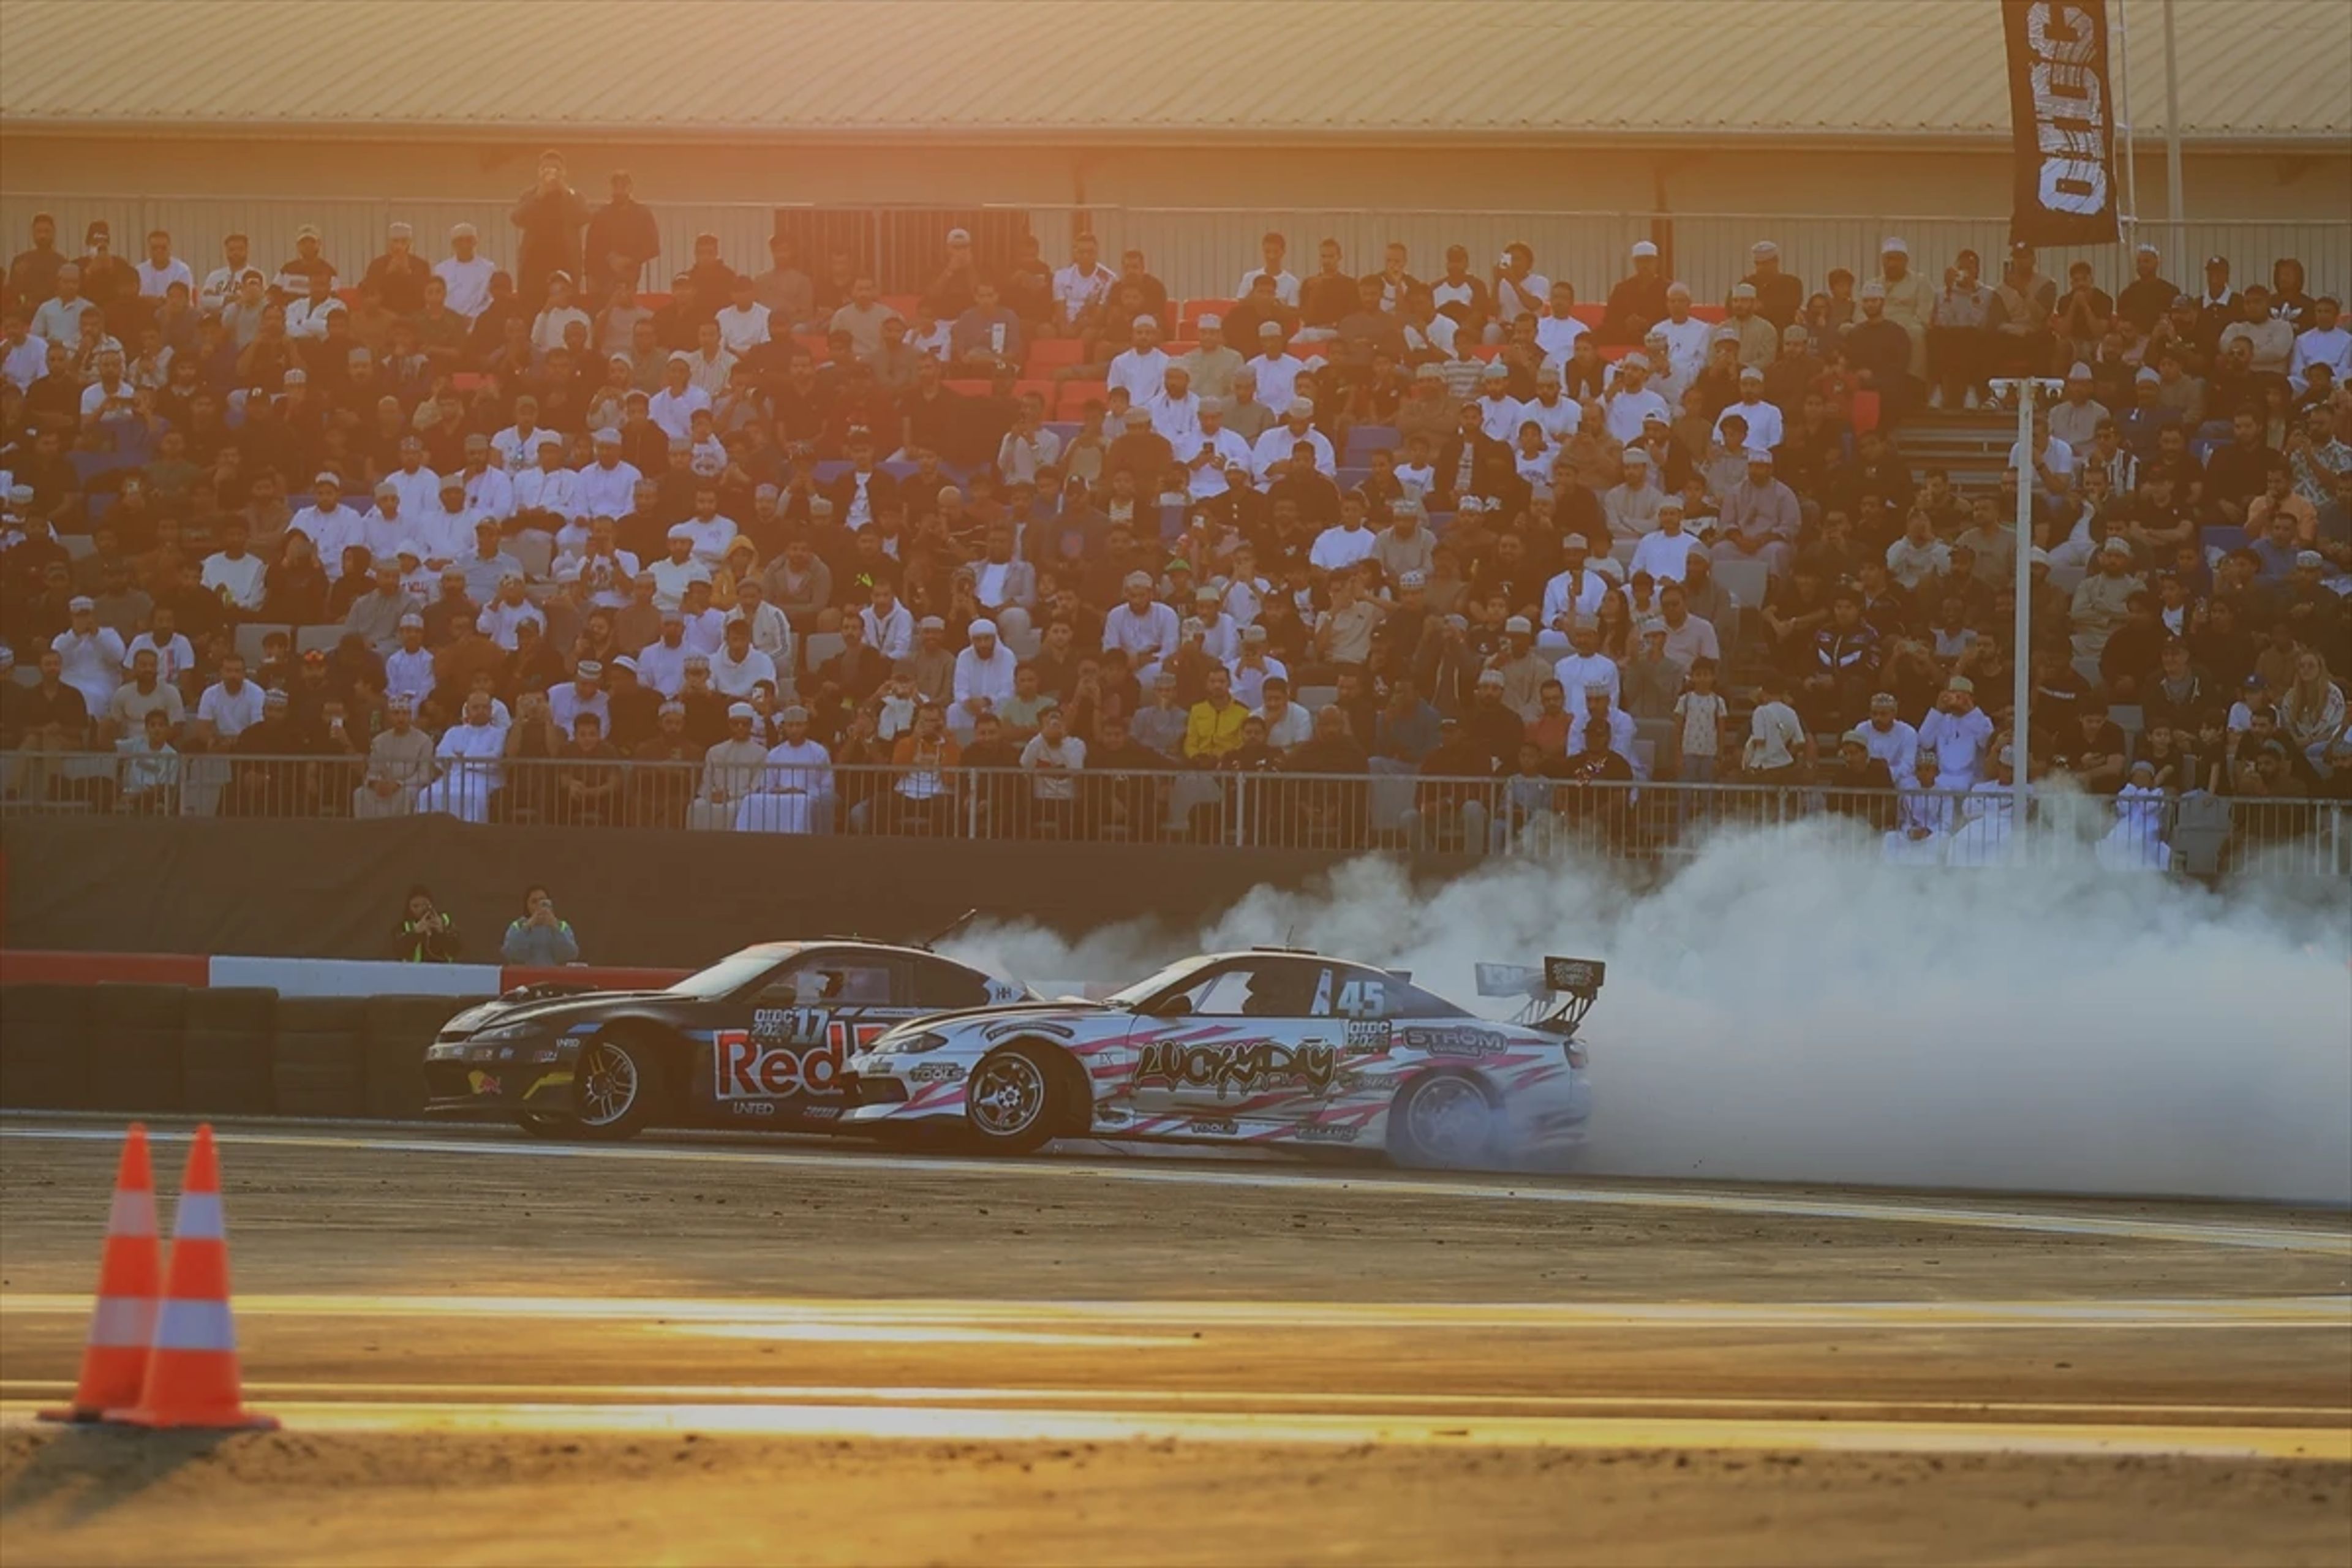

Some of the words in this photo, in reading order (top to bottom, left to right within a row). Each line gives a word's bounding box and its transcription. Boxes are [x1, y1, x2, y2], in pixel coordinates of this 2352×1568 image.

[2027, 2, 2107, 215] OIDC
[1336, 981, 1385, 1019] 45
[794, 1008, 829, 1044] 17
[1349, 1021, 1389, 1034] OIDC
[714, 1021, 849, 1099] Red
